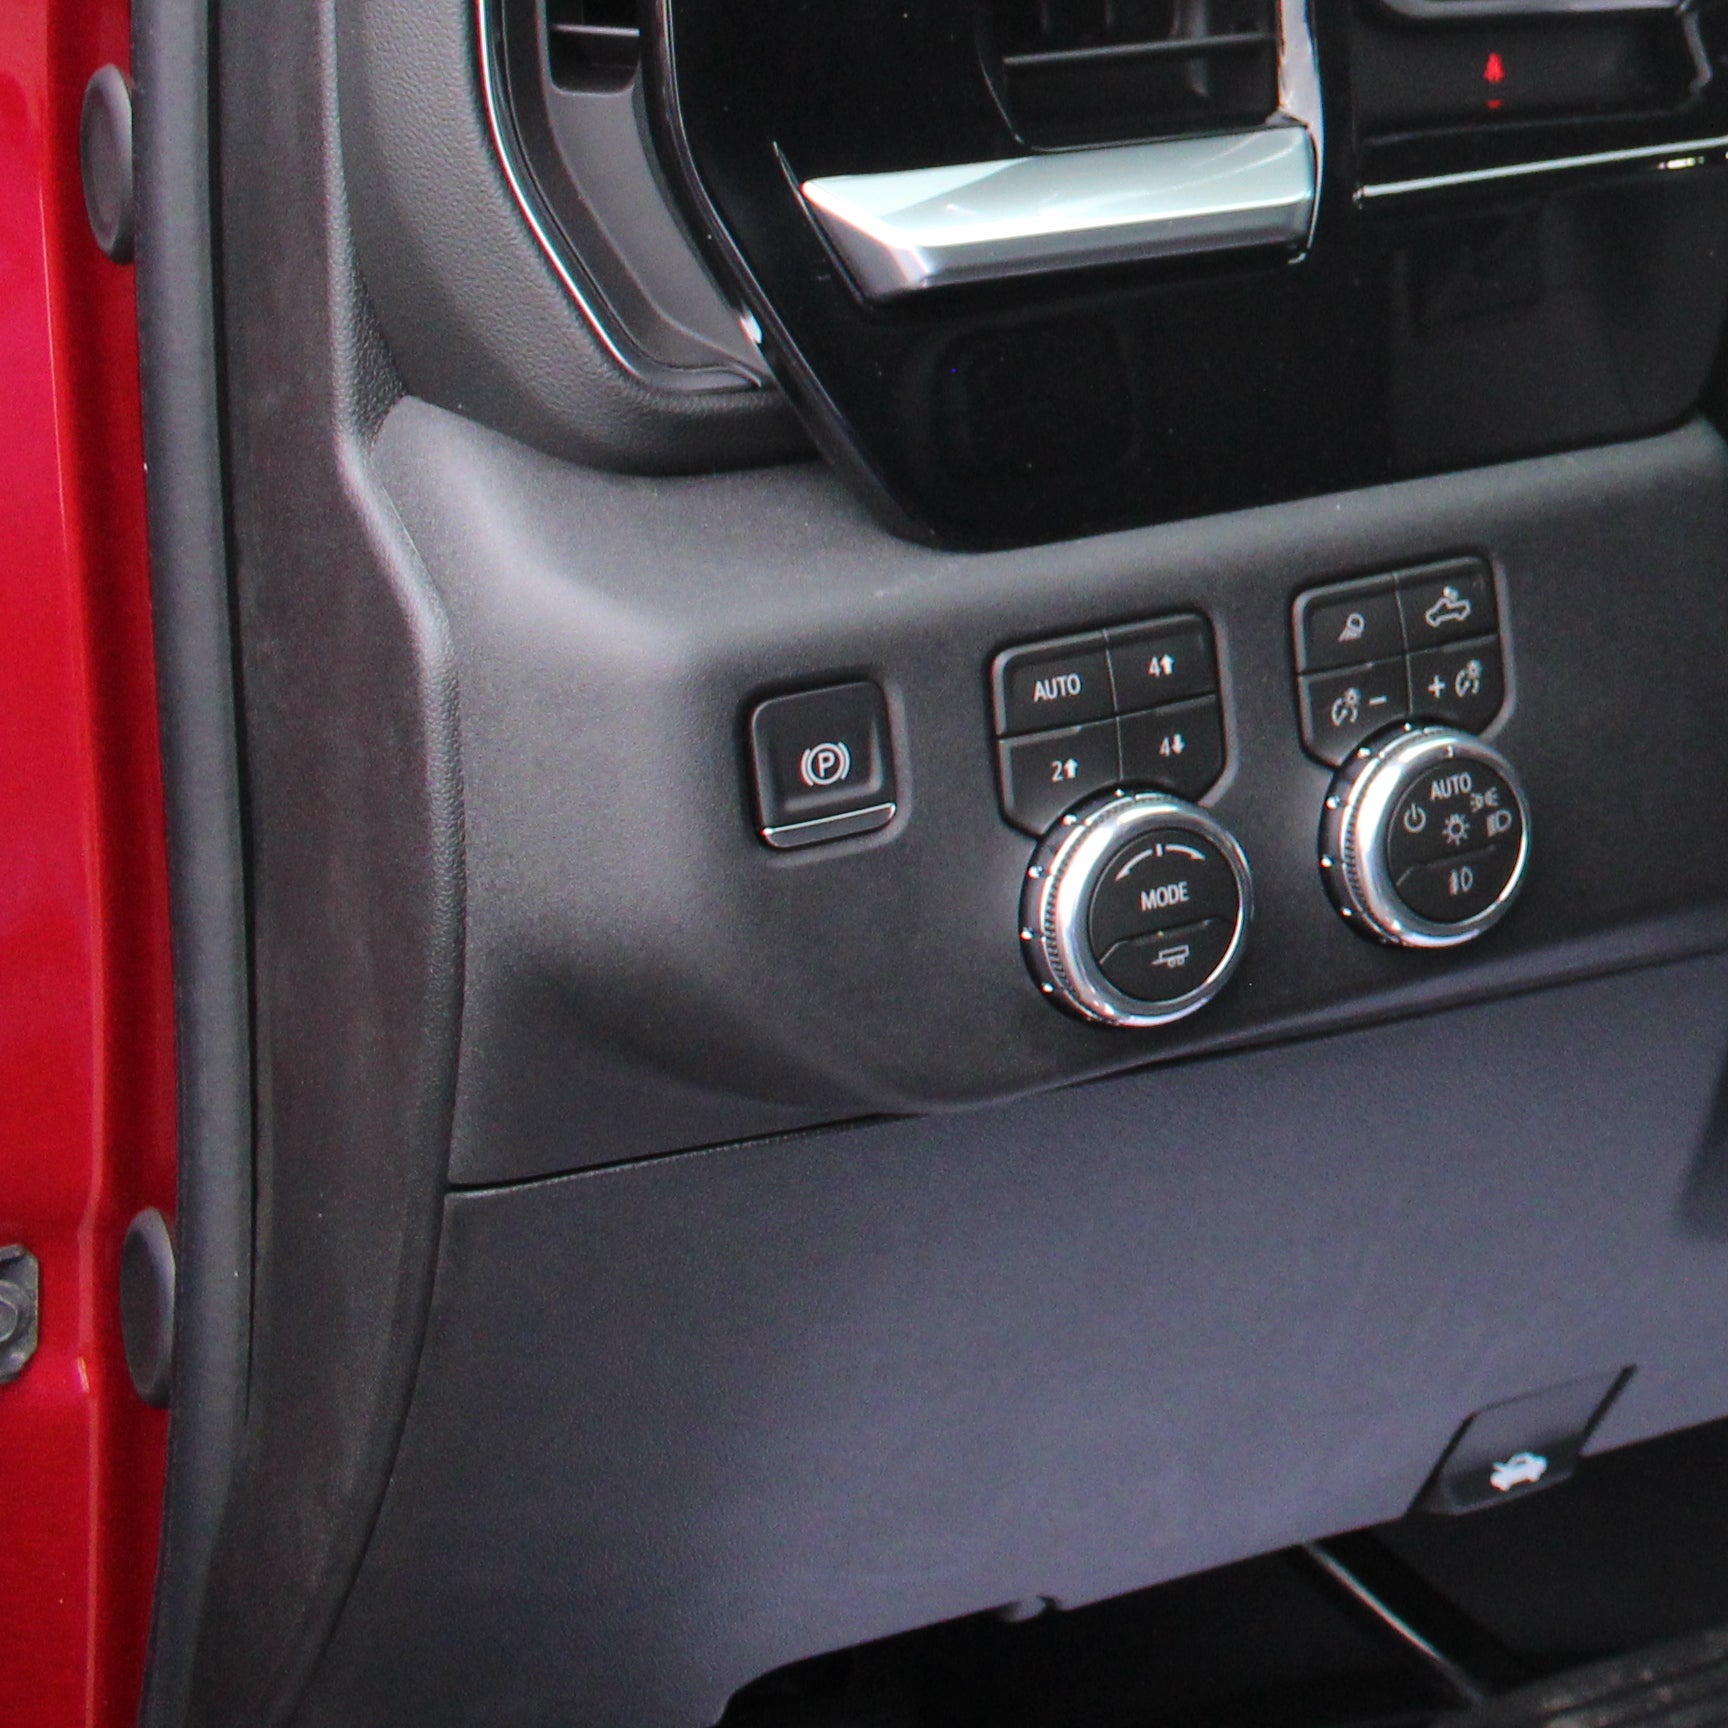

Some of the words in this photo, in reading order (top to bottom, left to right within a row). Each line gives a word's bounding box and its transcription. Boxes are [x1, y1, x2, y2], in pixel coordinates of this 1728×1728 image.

[1033, 673, 1082, 703] AUTO
[1429, 773, 1472, 801] AUTO
[1140, 881, 1190, 911] MODE
